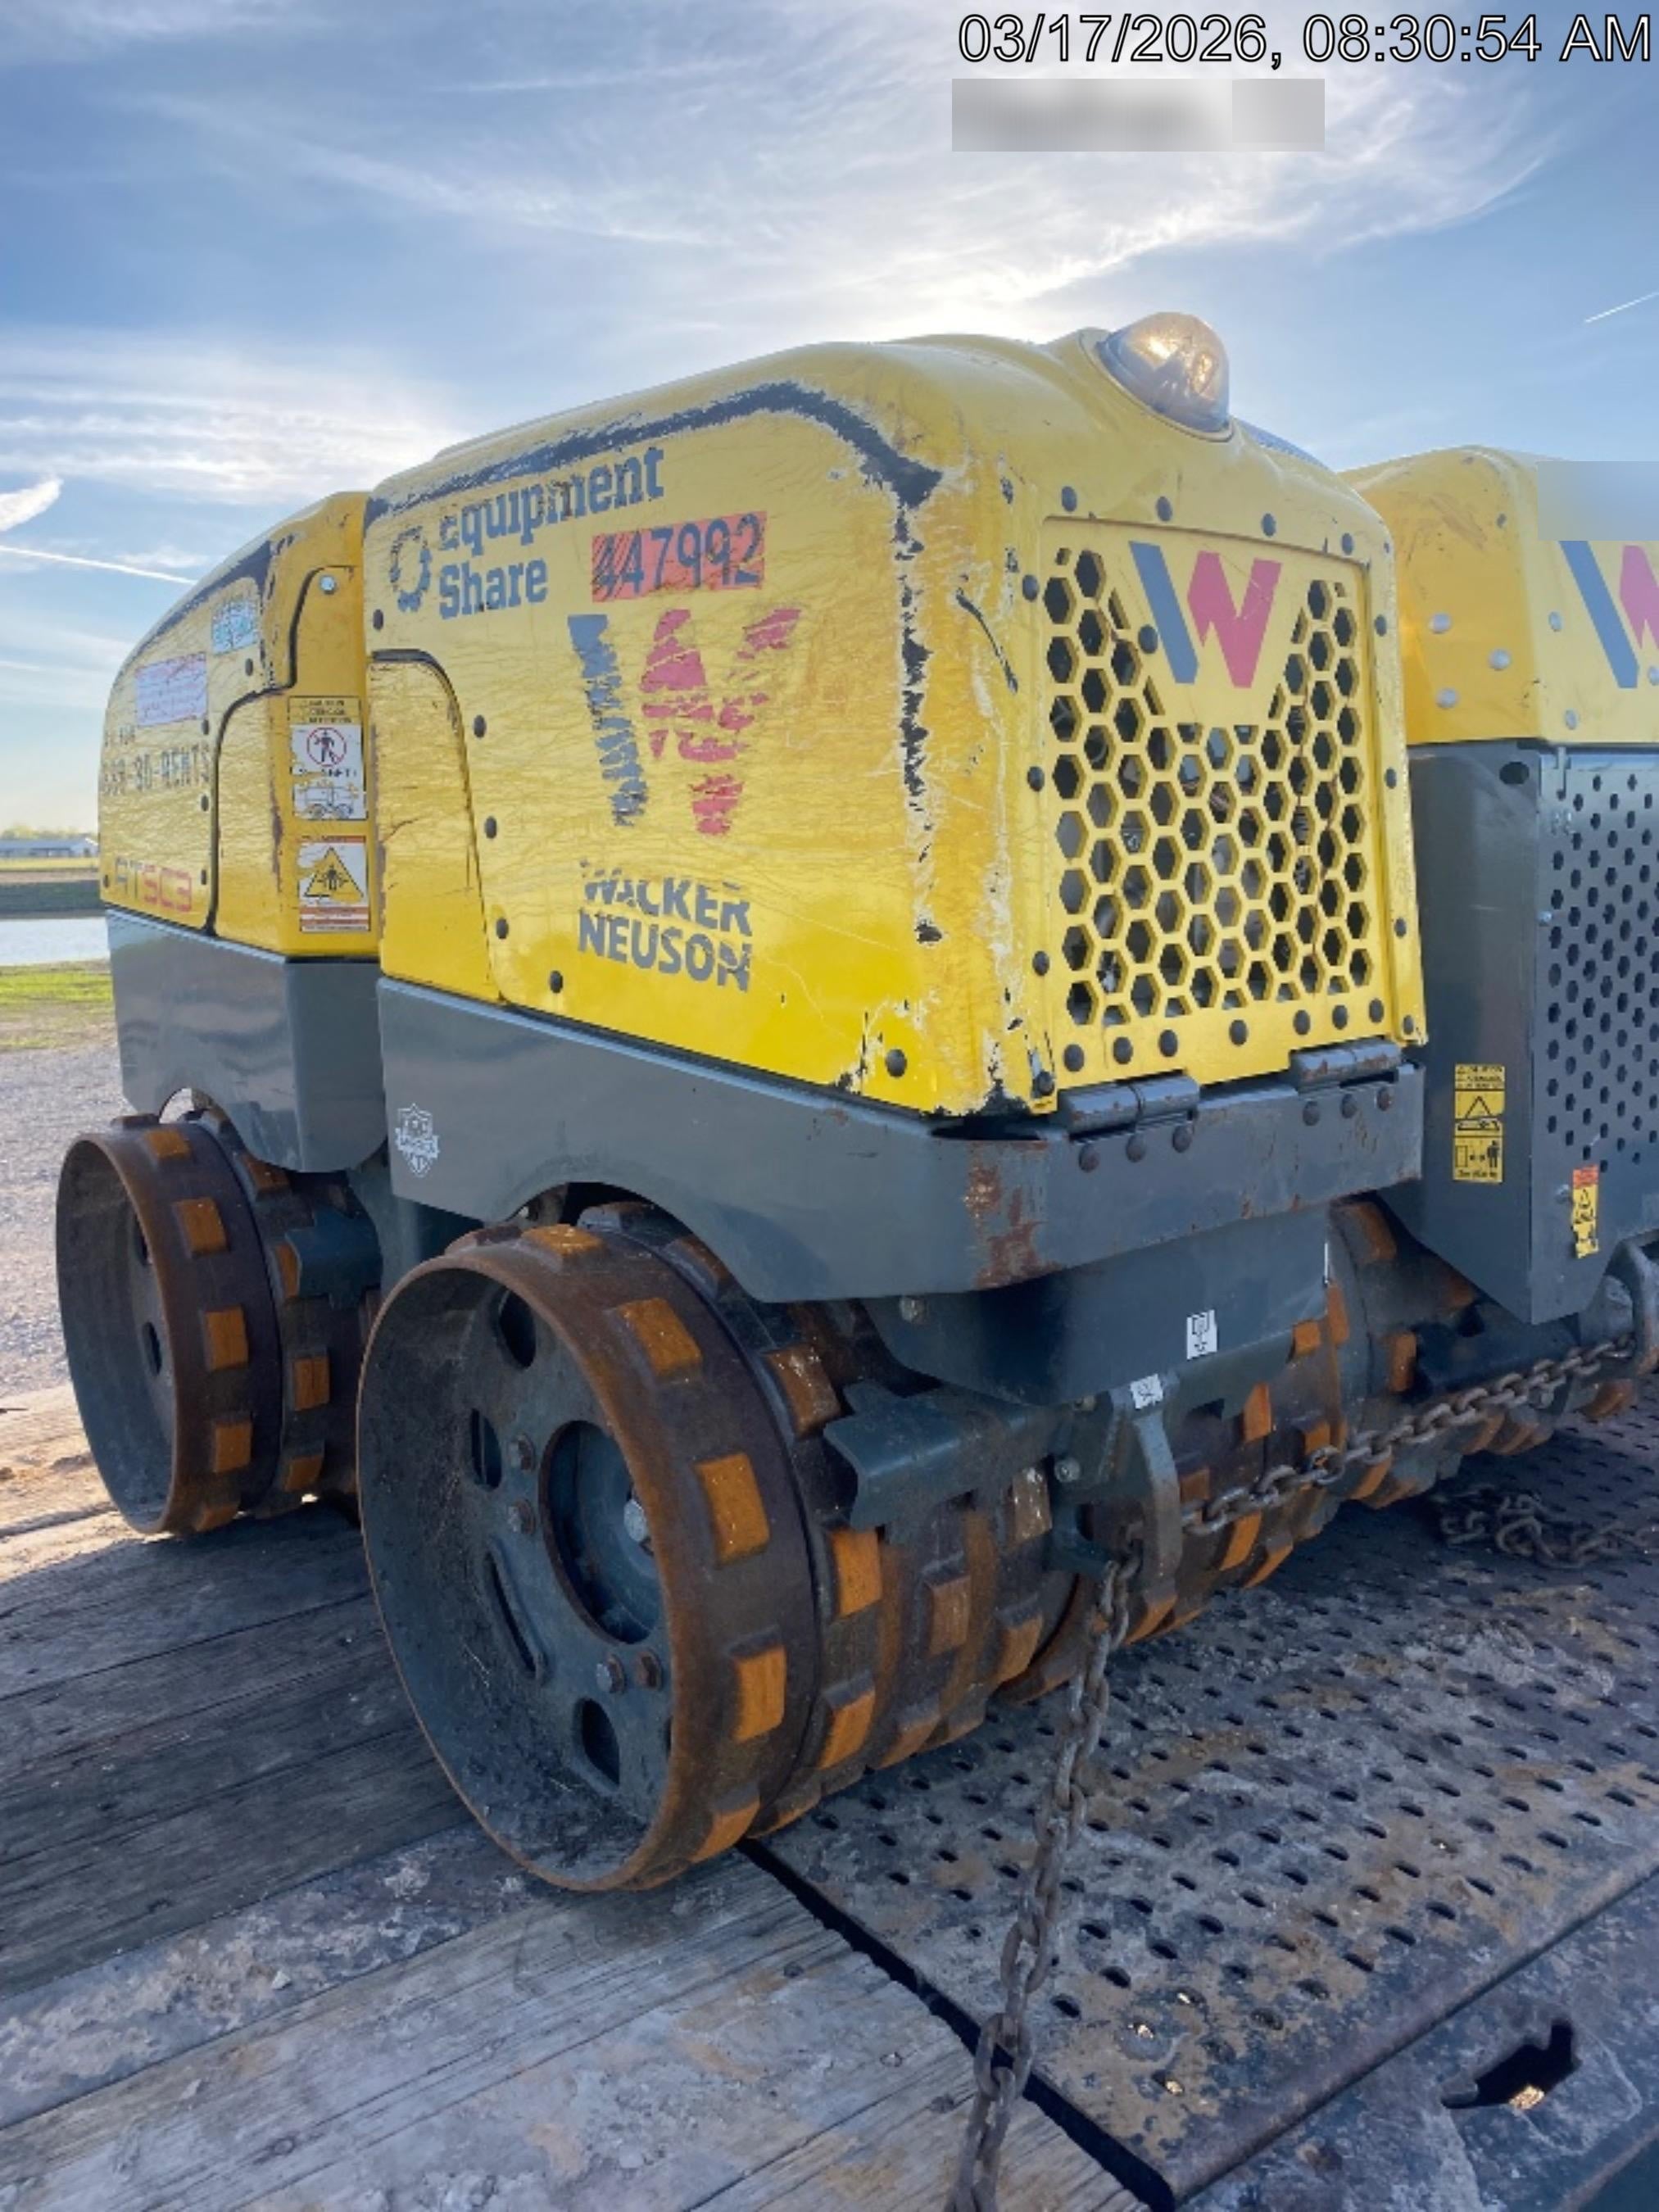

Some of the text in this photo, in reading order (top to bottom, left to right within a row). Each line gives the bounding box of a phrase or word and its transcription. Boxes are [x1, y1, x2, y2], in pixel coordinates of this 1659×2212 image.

[438, 558, 549, 620] Share
[579, 859, 753, 937] WACKER
[578, 907, 753, 994] NEUSON
